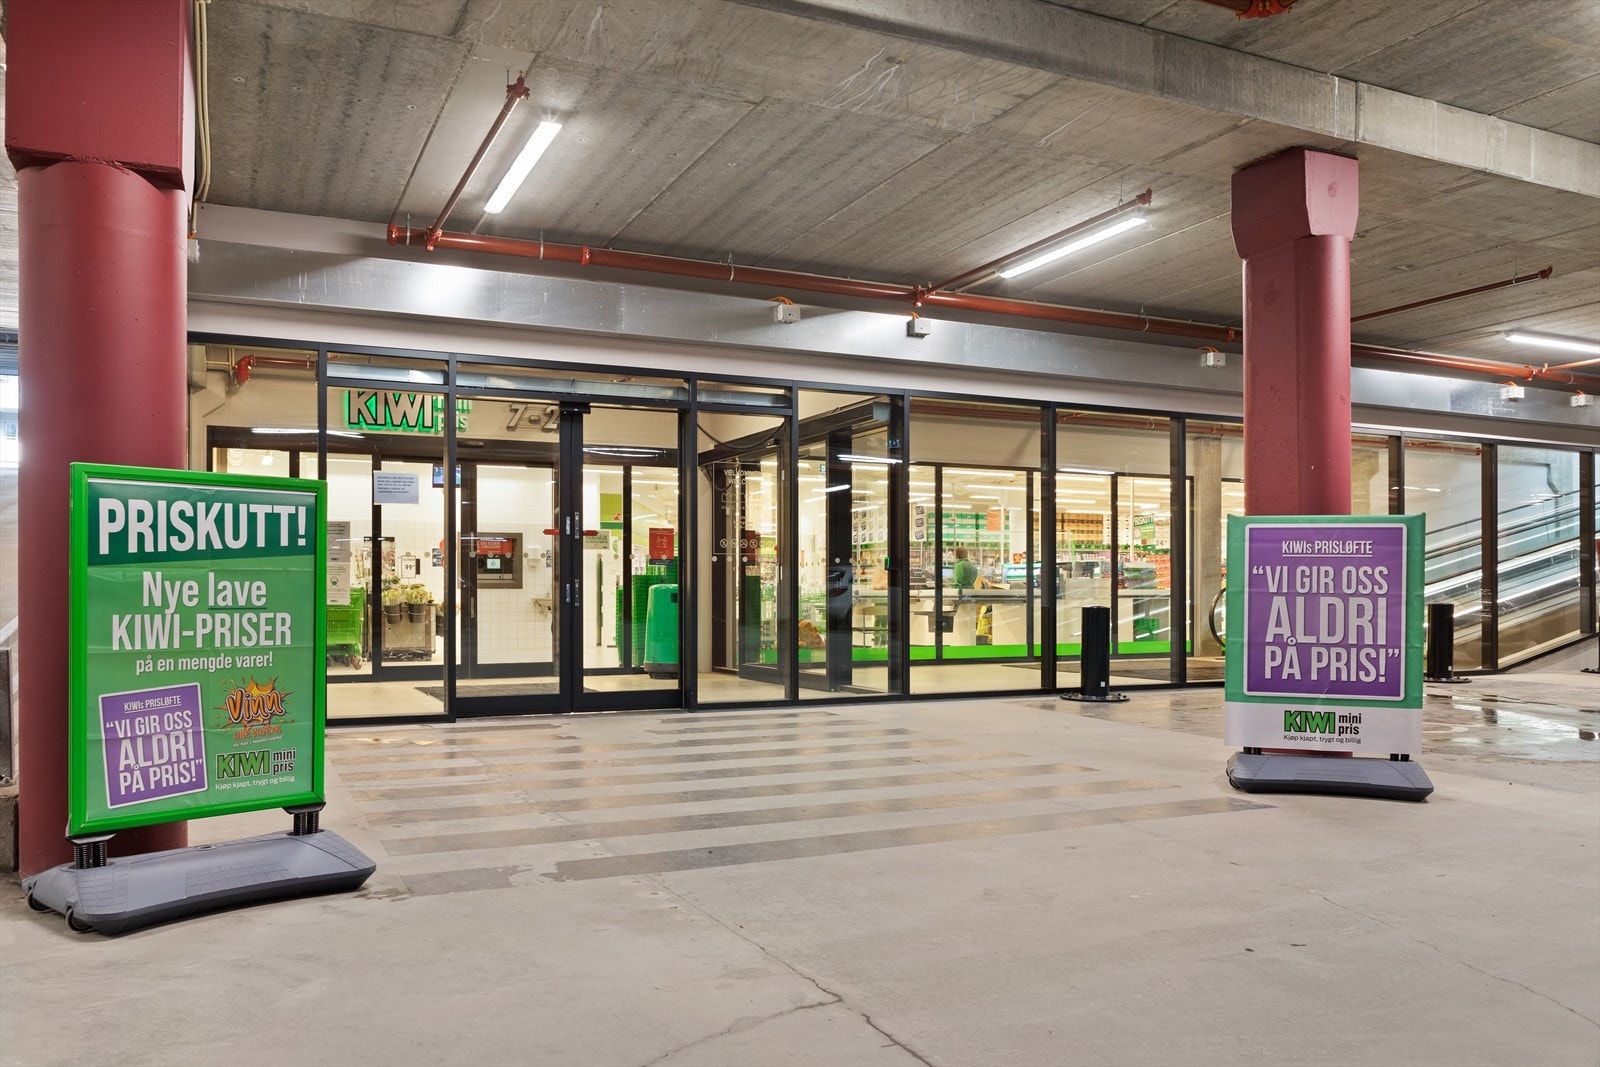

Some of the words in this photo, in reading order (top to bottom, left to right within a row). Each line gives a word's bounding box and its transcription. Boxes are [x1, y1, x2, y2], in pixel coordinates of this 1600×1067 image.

[347, 389, 434, 429] KIWI
[98, 497, 306, 555] PRISKUTT!
[1282, 540, 1312, 554] KIWIs
[1314, 540, 1373, 554] PRISLØFTE
[142, 571, 199, 614] Nye
[208, 571, 267, 607] lave
[1295, 565, 1335, 594] GIR
[1341, 565, 1389, 595] OSS
[112, 612, 292, 650] KIWI-PRISER
[1265, 595, 1387, 645] ALDRI
[136, 655, 153, 675] på
[157, 658, 174, 671] en
[178, 653, 232, 673] mengde
[236, 651, 273, 668] varer!
[1264, 636, 1302, 680] PÅ
[124, 702, 145, 711] KIWIs
[145, 695, 181, 709] PRISLØFTE
[225, 688, 286, 723] Vinn
[135, 715, 161, 736] GIR
[163, 710, 193, 731] OSS
[1284, 710, 1336, 734] KIWI
[1338, 712, 1362, 724] mini
[1338, 723, 1360, 736] pris
[119, 729, 195, 772] ALDRI
[1319, 736, 1335, 744] trygt
[216, 749, 271, 781] KIWI
[273, 747, 296, 761] mini
[273, 760, 294, 775] pris
[119, 764, 145, 795] PÅ
[215, 782, 232, 790] Kjøp
[232, 779, 252, 789] kjapt,
[252, 778, 269, 787] trygt
[279, 775, 295, 783] billig
